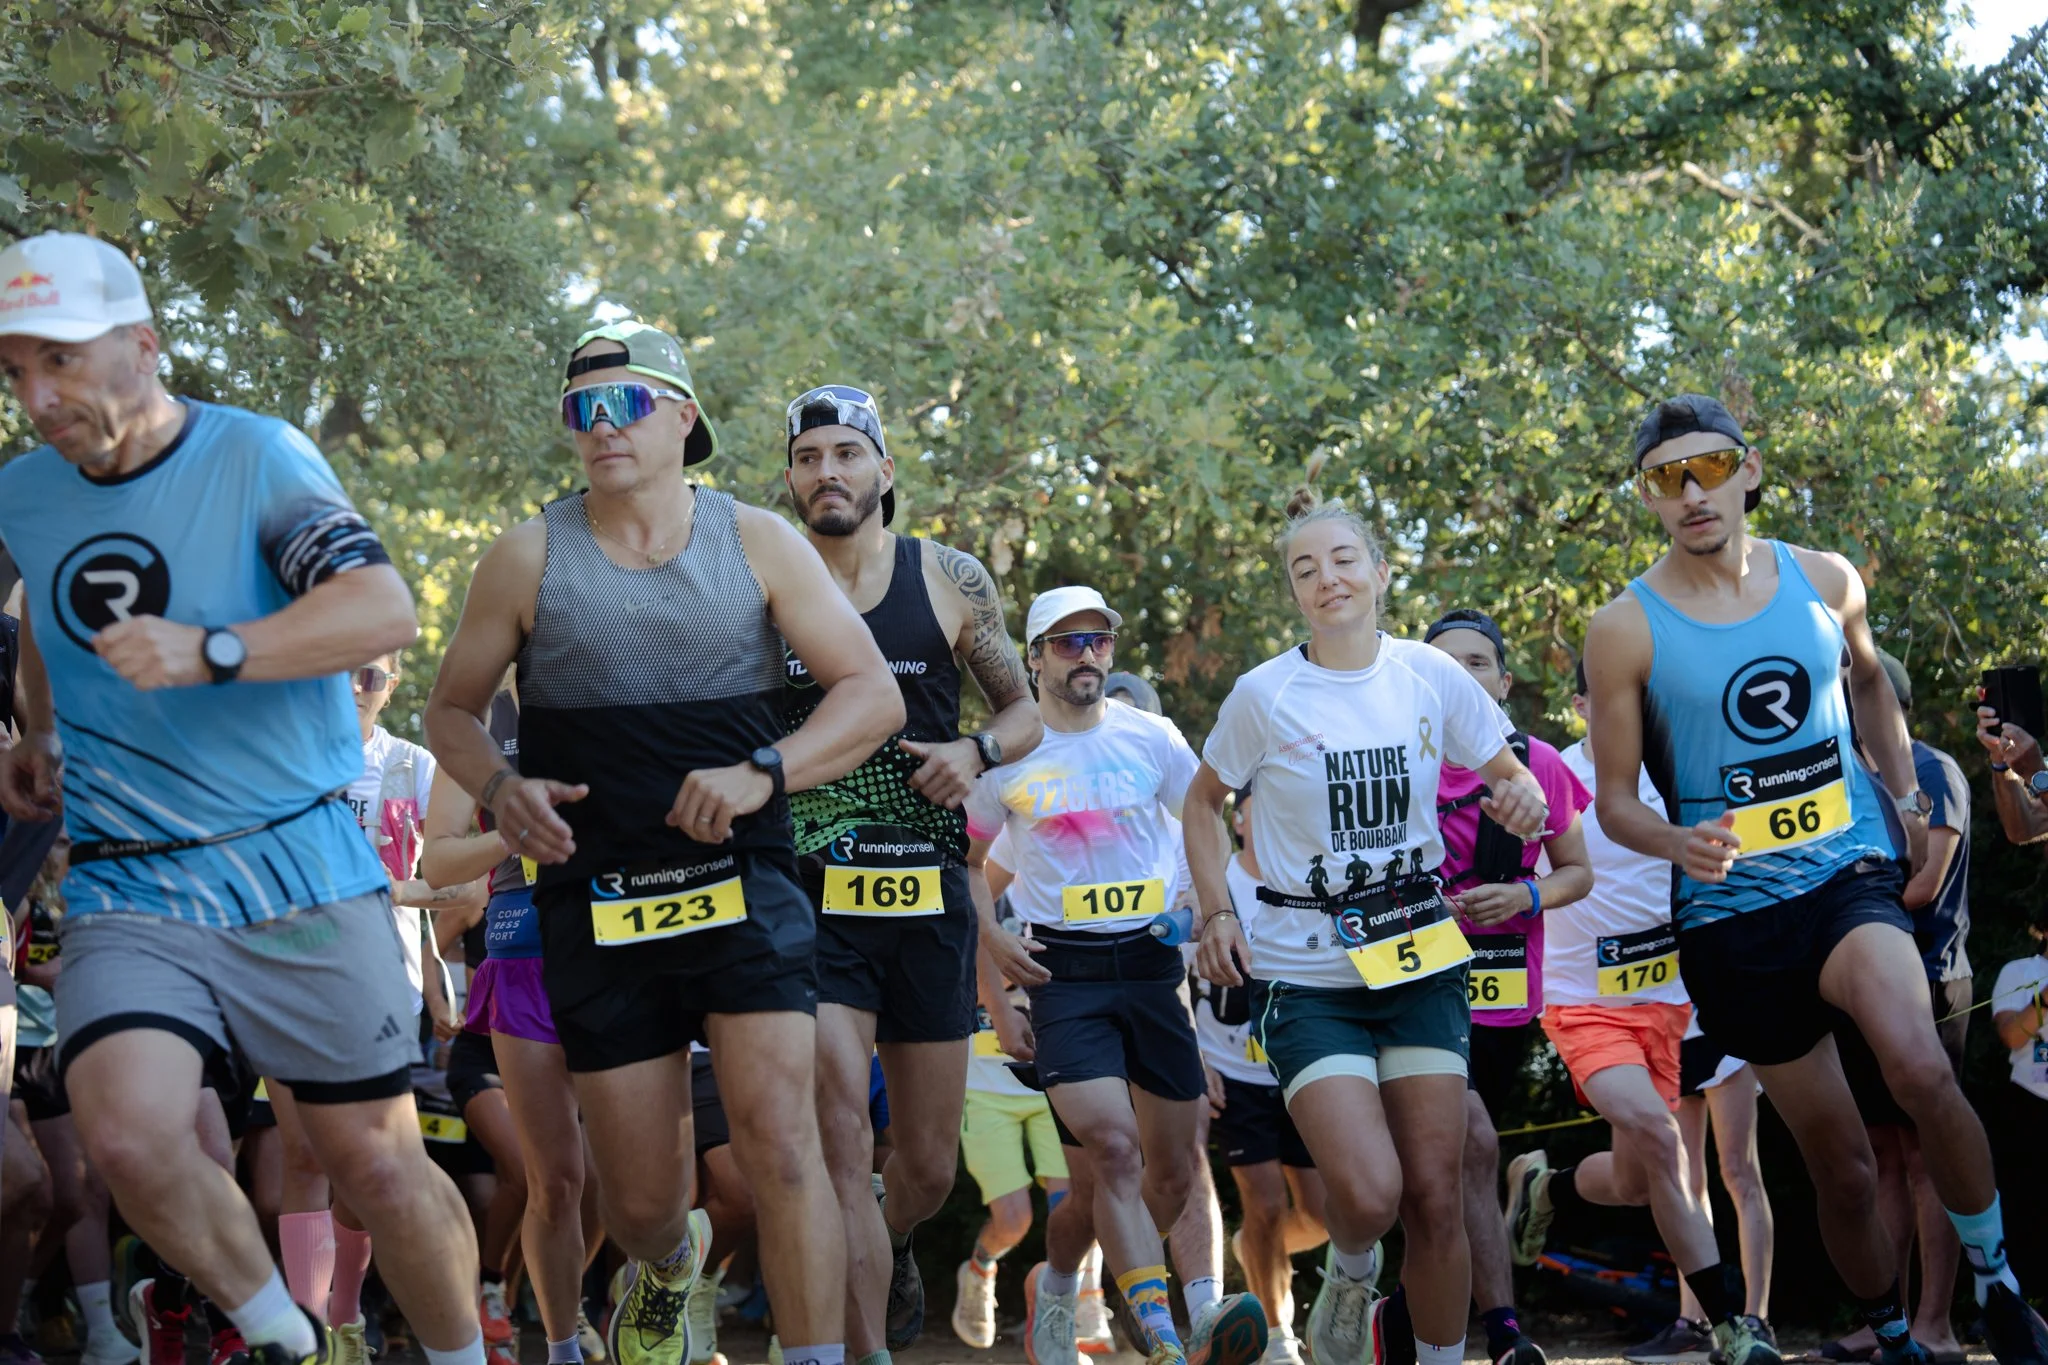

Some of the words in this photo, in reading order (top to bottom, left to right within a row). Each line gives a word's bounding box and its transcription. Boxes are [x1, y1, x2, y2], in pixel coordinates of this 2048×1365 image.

[1278, 731, 1324, 754] Association
[1324, 744, 1409, 782] NATURE
[1758, 752, 1839, 788] runningconseil
[1328, 775, 1411, 832] RUN
[1769, 800, 1821, 840] 66
[859, 842, 935, 857] runningconseil
[1331, 831, 1347, 853] DE
[631, 854, 734, 887] runningconseil
[847, 874, 921, 907] 169
[1082, 884, 1145, 915] 107
[1283, 898, 1326, 908] PRESSPORT
[494, 920, 520, 930] RESS
[497, 908, 529, 919] COMP
[622, 895, 716, 933] 123
[1369, 895, 1441, 928] runningconseil
[489, 931, 516, 941] PORT
[1397, 941, 1422, 973] 5
[1474, 946, 1525, 960] ningconseil
[1616, 961, 1667, 991] 170
[427, 1119, 440, 1136] 4
